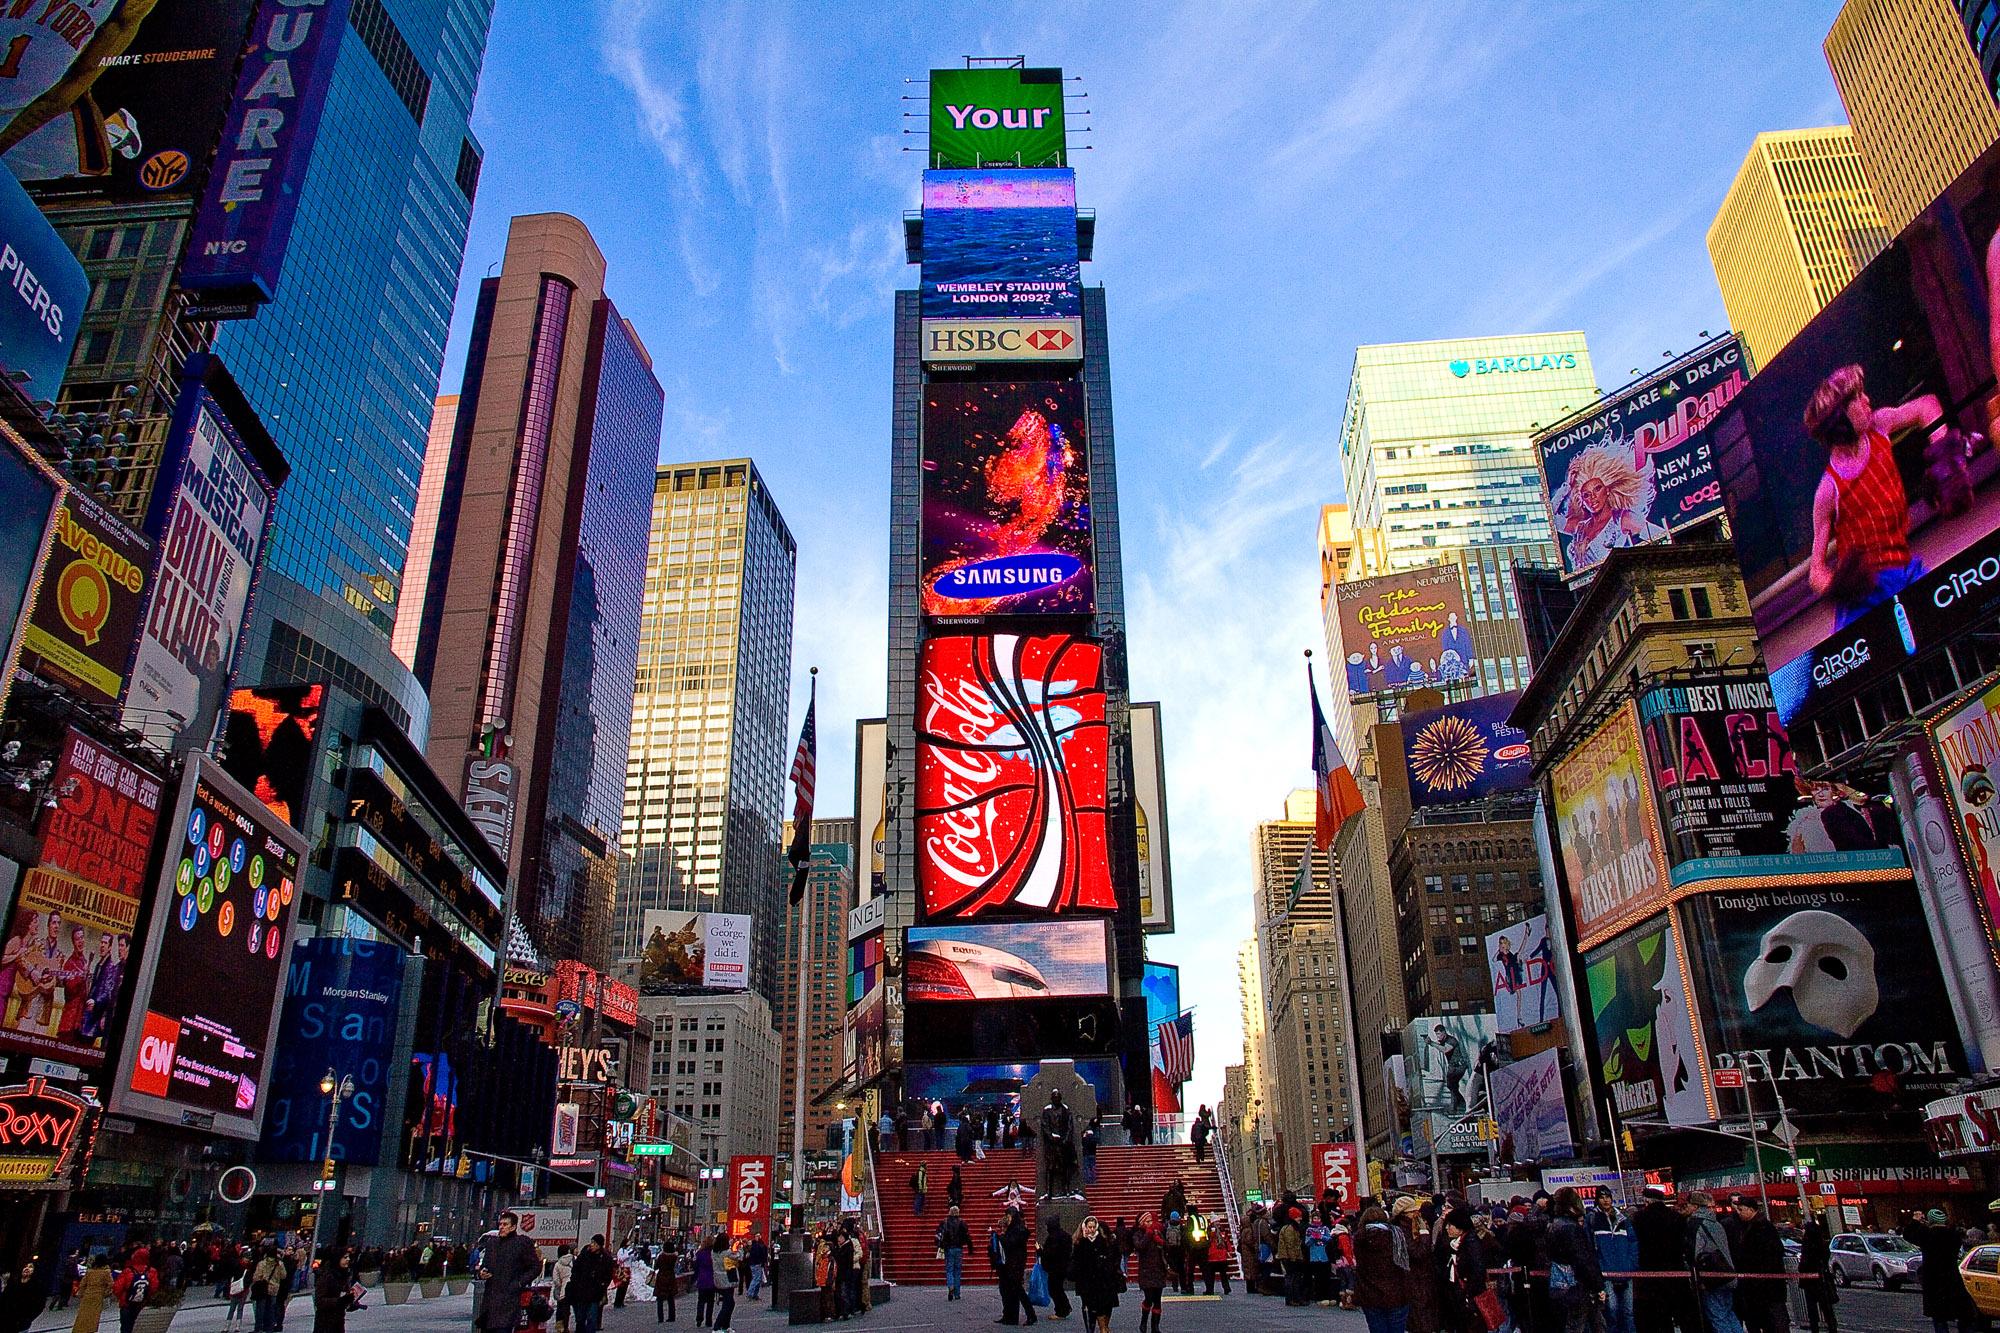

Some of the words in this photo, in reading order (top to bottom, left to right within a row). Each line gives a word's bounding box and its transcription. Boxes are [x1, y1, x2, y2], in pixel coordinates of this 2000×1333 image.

[99, 54, 141, 66] AMAR'E
[143, 48, 216, 64] STOUDEMIRE
[220, 0, 326, 202] UARE
[946, 105, 1050, 129] Your
[142, 155, 189, 188] NYK
[204, 240, 247, 256] NYC
[0, 244, 63, 342] PIERS.
[936, 284, 1003, 293] WEMBLEY
[1006, 282, 1066, 291] STADIUM
[952, 294, 1009, 303] LONDON
[1012, 293, 1051, 302] 2092?
[930, 329, 1021, 352] HSBC
[931, 363, 972, 371] SHERWOOD
[1475, 353, 1577, 375] BARCLAYS
[1544, 411, 1622, 458] MONDAYS
[1628, 390, 1661, 415] ARE
[1668, 380, 1681, 395] A
[1686, 348, 1739, 385] DRAG
[1657, 453, 1690, 479] NEW
[1661, 473, 1687, 491] MON
[1691, 462, 1712, 478] JAN
[67, 483, 104, 516] ROADWAY'S
[207, 453, 249, 521] BEST
[80, 504, 99, 521] BEST
[99, 519, 129, 545] MUSICAL
[182, 457, 254, 567] MUSICAL
[54, 504, 144, 594] Avenue
[166, 495, 227, 606] BILLY
[217, 553, 236, 600] MUSICAL
[953, 567, 1063, 585] SAMSUNG
[1438, 565, 1458, 575] BEBE
[1934, 556, 2000, 607] CÎRO
[1338, 579, 1375, 592] NATHAN
[1416, 574, 1459, 588] NEUWIRTH
[1338, 590, 1361, 601] LANE
[57, 559, 111, 647] Q
[1380, 589, 1420, 604] The
[148, 565, 220, 668] ELLIOT
[937, 616, 979, 625] SHERWOOD
[1358, 601, 1446, 624] Addams
[1367, 617, 1444, 639] Family
[1388, 637, 1400, 646] NEW
[1401, 634, 1427, 644] MUSICAL
[1813, 638, 1869, 682] CÎROC
[1817, 678, 1831, 689] THE
[1832, 666, 1848, 680] NEW
[1848, 653, 1871, 671] YEAR!
[1686, 685, 1723, 712] BEST
[1725, 682, 1775, 709] MUSIC
[73, 739, 96, 764] ELVIS
[1646, 716, 1720, 791] LA
[1725, 712, 1798, 779] CA
[1941, 705, 2000, 783] WOM
[70, 755, 93, 775] PRESLEY
[94, 763, 117, 787] LEWIS
[120, 767, 138, 789] CARL
[1683, 786, 1711, 796] GRAMMER
[1720, 784, 1746, 794] DOUGLAS
[60, 772, 156, 847] ONE
[139, 789, 158, 811] CASH
[464, 760, 512, 858] HEY'S
[1676, 801, 1686, 812] LA
[1688, 799, 1706, 810] CAGE
[1708, 798, 1722, 809] AUX
[1724, 797, 1751, 808] FOLLES
[235, 815, 254, 835] 40411
[502, 801, 515, 862] Chocolate
[50, 808, 148, 872] ELECTRIFYING
[42, 832, 143, 897] NIGHT
[29, 871, 72, 904] MILLION
[1579, 859, 1622, 924] JERSEY
[1620, 838, 1658, 900] BOYS
[26, 895, 64, 911] INSPIRED
[76, 910, 91, 920] THE
[92, 915, 110, 926] TRUE
[110, 922, 133, 932] STORY
[1714, 892, 1770, 911] Tonight
[1772, 893, 1827, 907] belongs
[1830, 891, 1860, 903] to...
[710, 927, 746, 939] George,
[723, 918, 734, 929] By
[714, 948, 729, 957] did
[730, 949, 739, 957] it.
[952, 945, 982, 957] EQUUS
[503, 962, 549, 987] eese's
[1495, 956, 1556, 996] ALD
[140, 1036, 174, 1075] CNN
[176, 1055, 191, 1067] Follow
[192, 1061, 203, 1072] these
[1715, 1041, 1955, 1082] PHANTOM
[184, 1072, 195, 1082] CNN
[195, 1075, 210, 1087] Mobile
[1450, 1123, 1479, 1134] SOUT
[1323, 1149, 1352, 1203] tkts
[1833, 1167, 1888, 1180] sbarro
[739, 1160, 765, 1213] tkts
